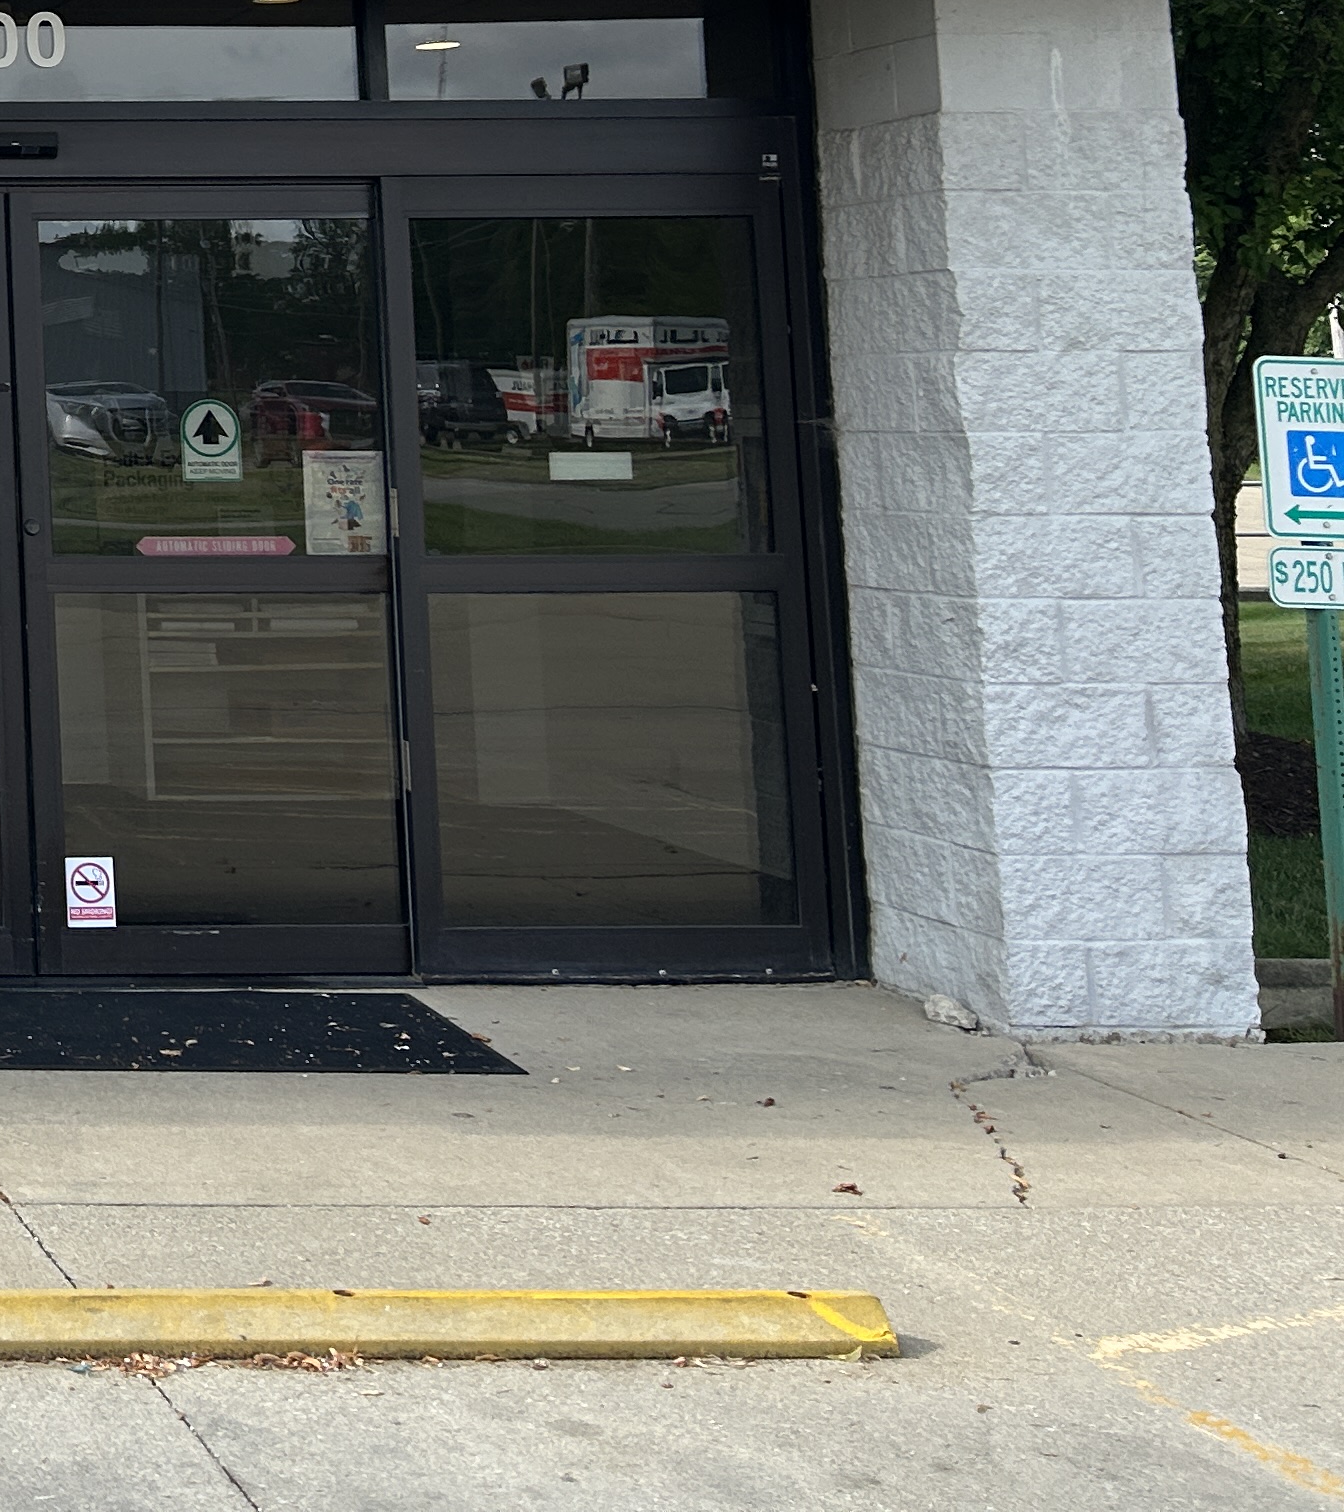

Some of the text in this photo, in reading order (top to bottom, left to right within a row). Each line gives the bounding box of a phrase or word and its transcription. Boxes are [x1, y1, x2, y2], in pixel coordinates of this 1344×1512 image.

[1265, 376, 1344, 399] RESERV
[1277, 401, 1344, 423] PARKIN
[156, 541, 277, 552] AUTOMATIC SLIDING DOOR
